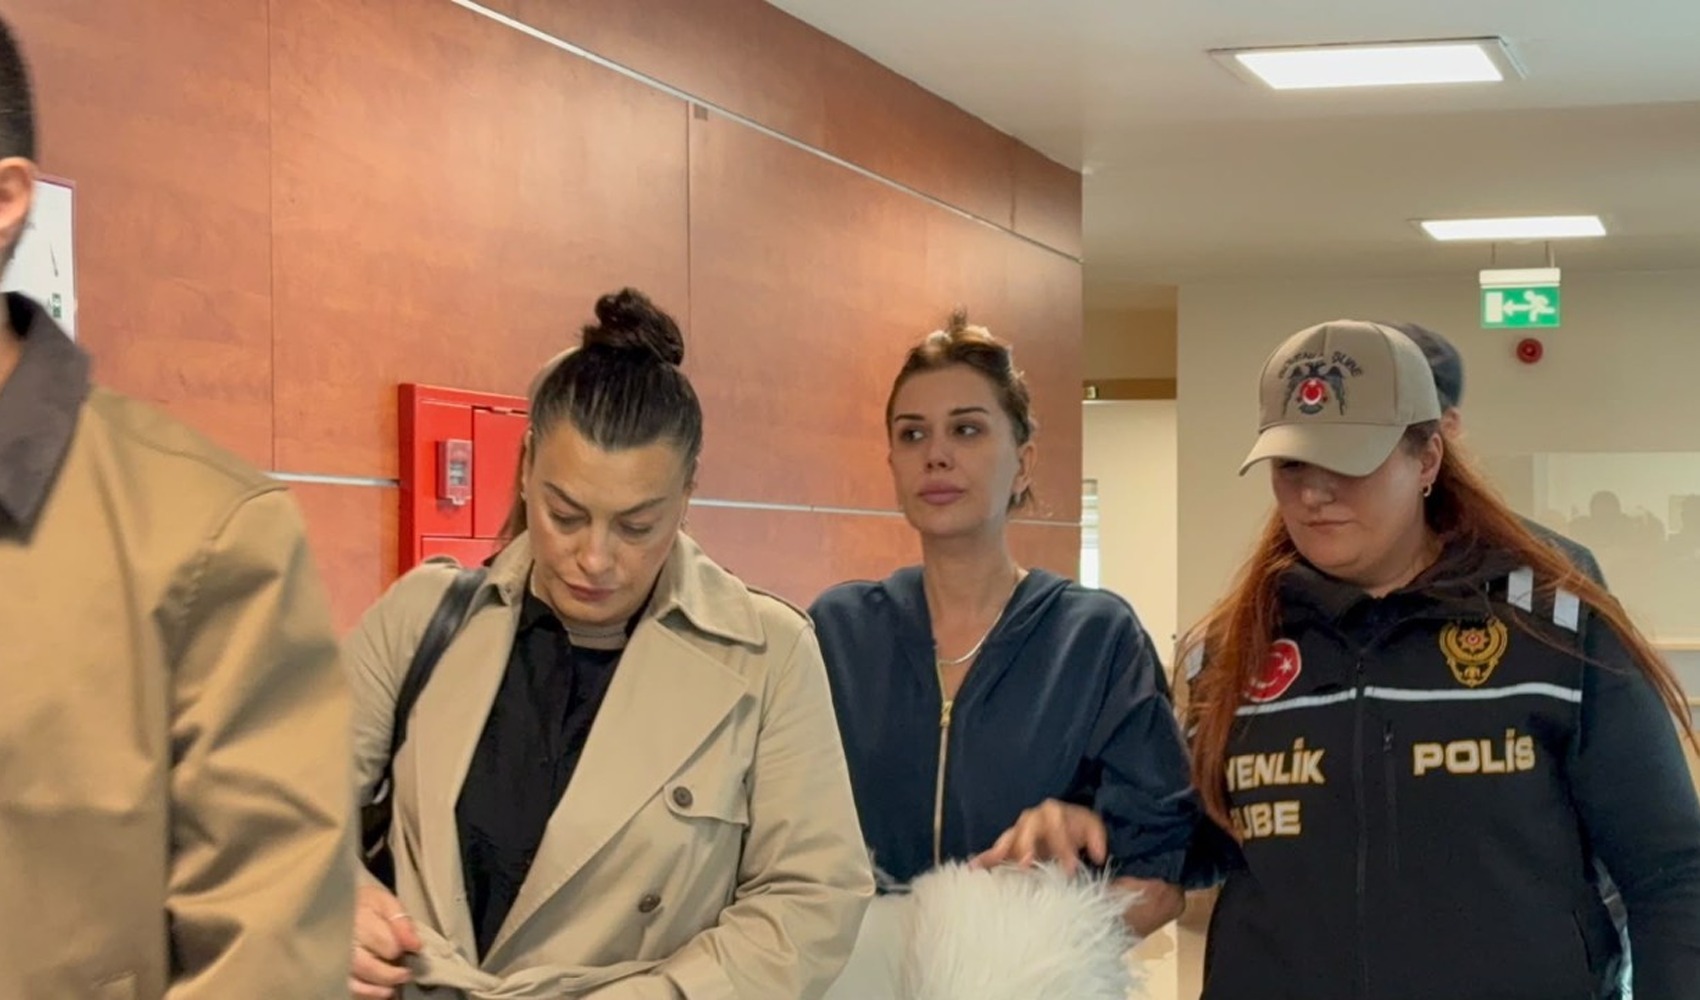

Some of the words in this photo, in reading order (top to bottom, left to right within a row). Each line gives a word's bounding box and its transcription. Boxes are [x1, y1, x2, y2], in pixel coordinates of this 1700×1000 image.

[1224, 737, 1326, 793] VENLİK
[1413, 728, 1536, 776] POLİS
[1229, 800, 1302, 840] UBE
